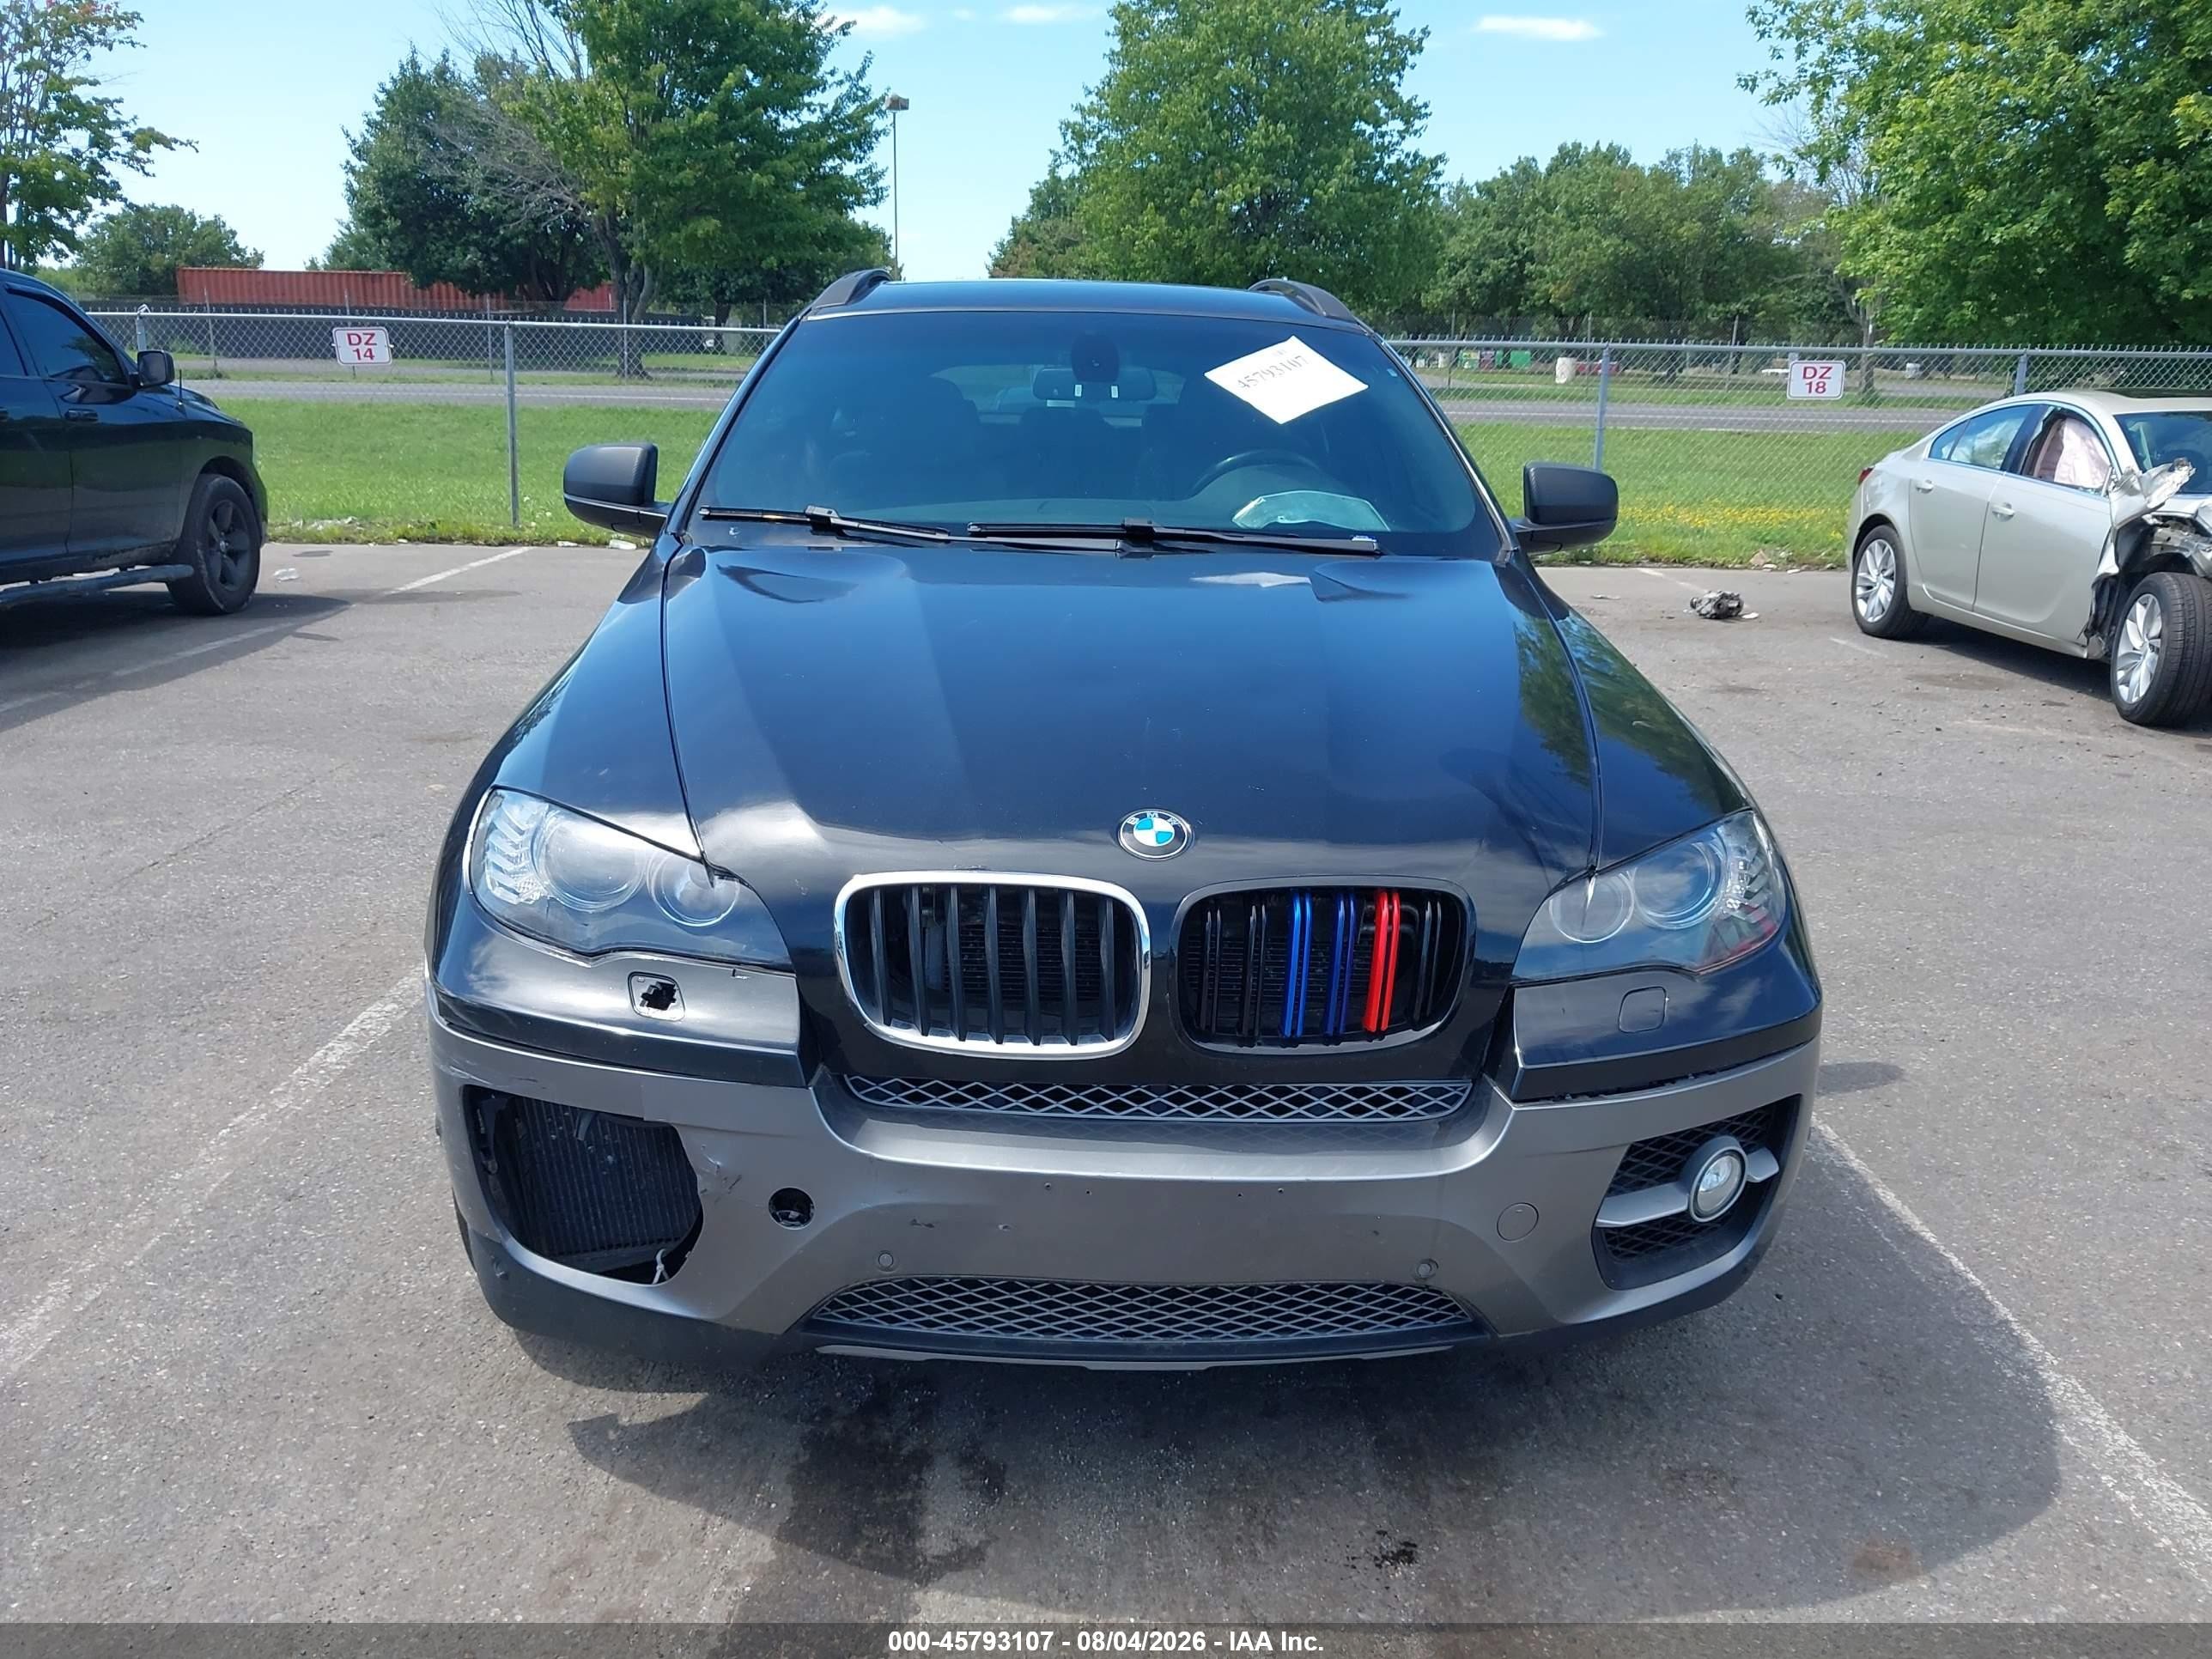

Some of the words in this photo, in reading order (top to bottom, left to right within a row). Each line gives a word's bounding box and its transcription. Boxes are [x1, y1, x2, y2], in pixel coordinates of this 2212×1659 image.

[347, 332, 378, 345] DZ
[352, 348, 375, 361] 14
[1802, 366, 1832, 380] DZ
[1805, 380, 1826, 394] 18
[1126, 811, 1182, 825] BMW
